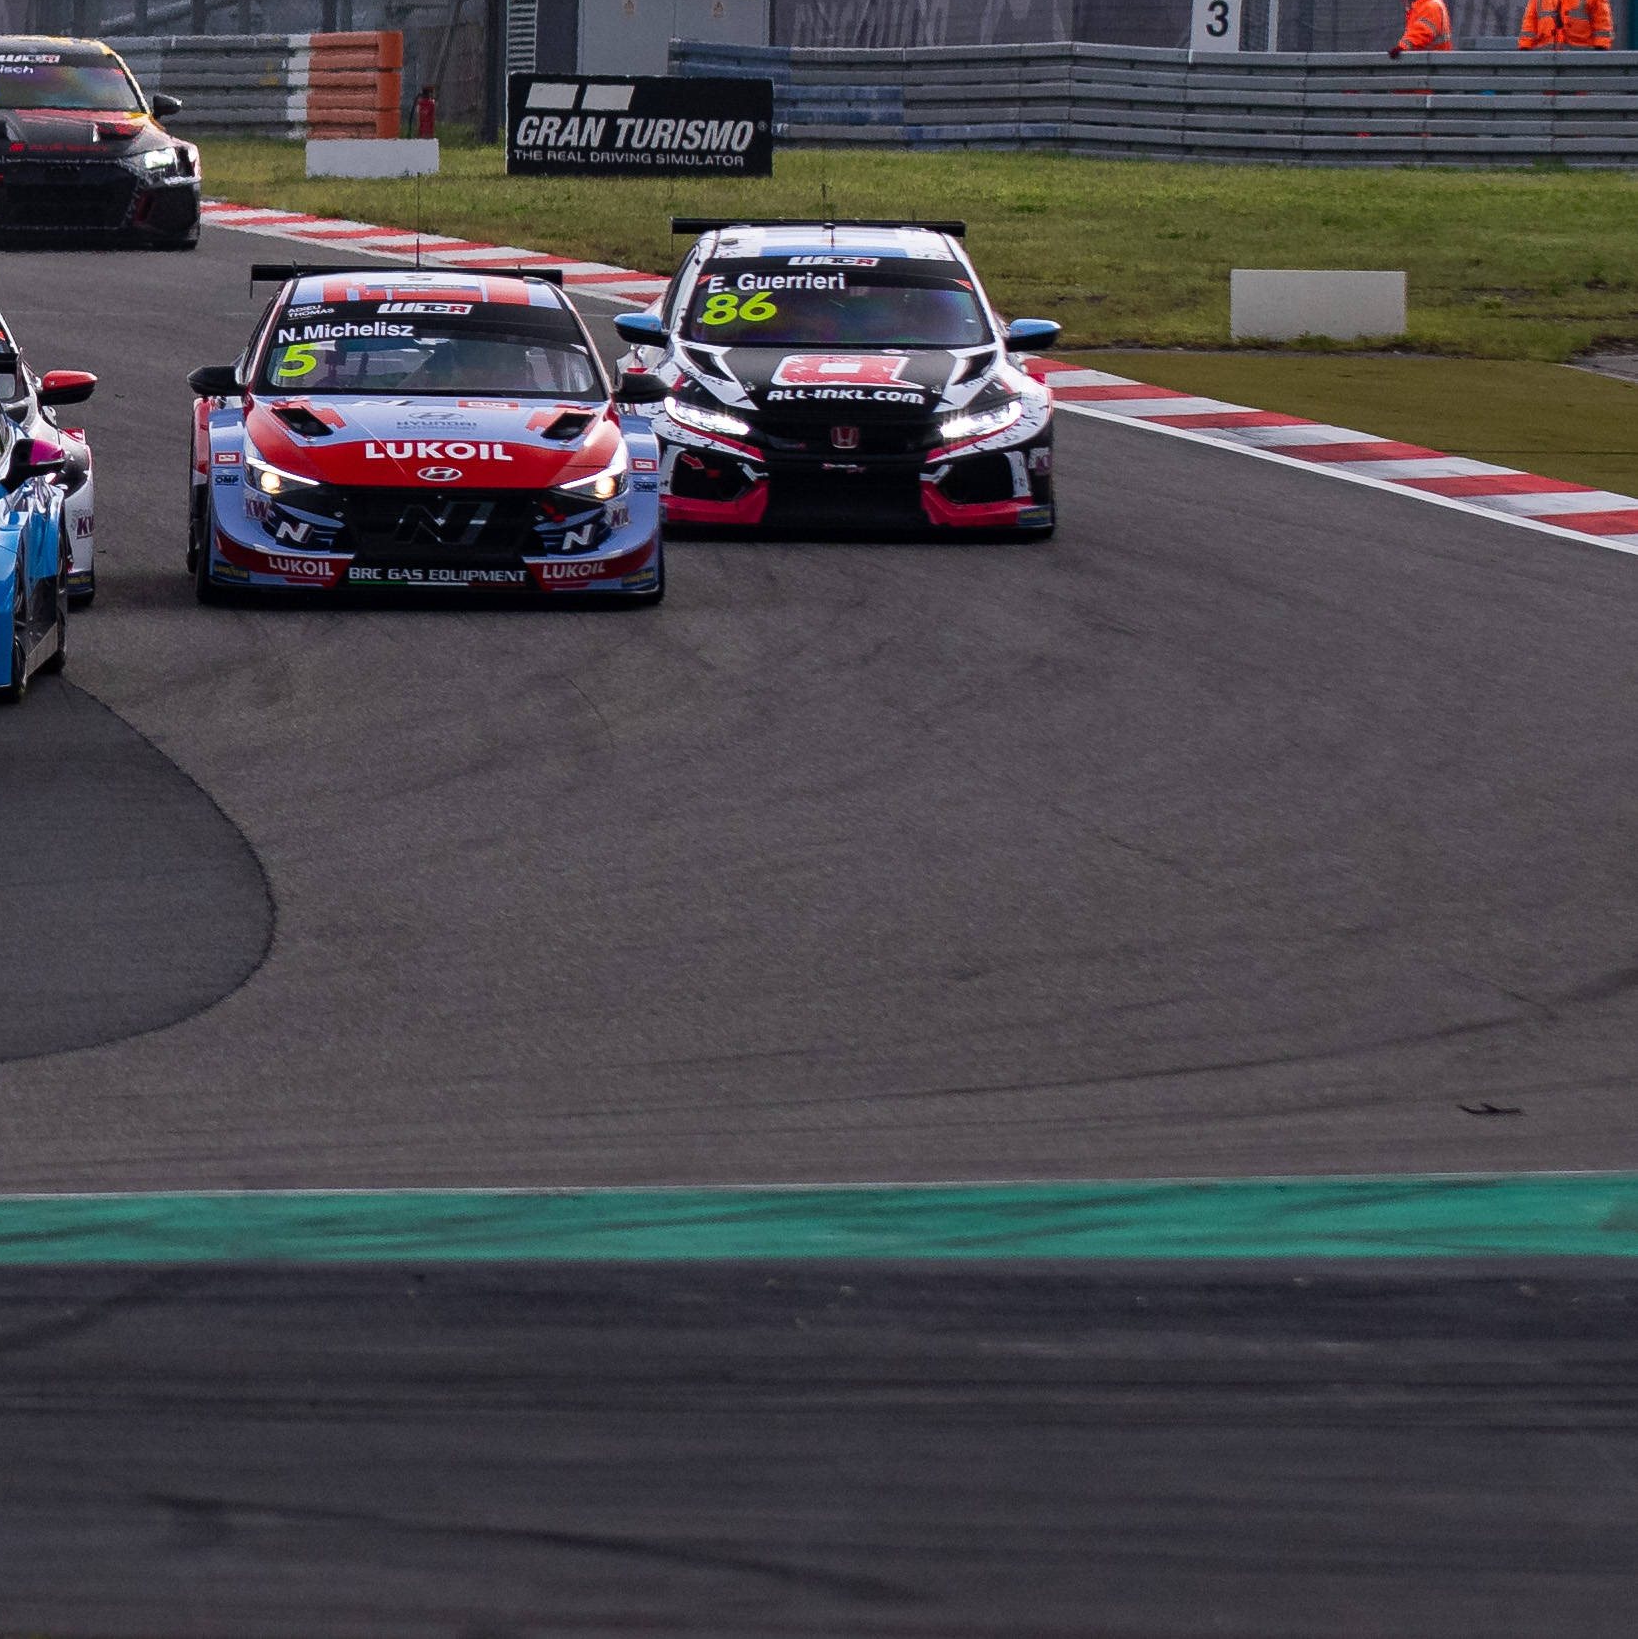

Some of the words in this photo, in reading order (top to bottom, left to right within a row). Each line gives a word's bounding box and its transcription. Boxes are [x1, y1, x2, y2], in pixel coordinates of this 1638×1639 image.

[1206, 0, 1229, 37] 3
[516, 116, 605, 147] GRAN
[614, 118, 754, 152] TURISMO
[514, 150, 543, 161] THE
[550, 150, 585, 163] REAL
[590, 151, 652, 164] DRIVING
[656, 153, 744, 167] SIMULATOR
[707, 276, 729, 294] E.
[737, 272, 845, 290] Guerrieri
[376, 303, 473, 314] WTCR
[701, 291, 777, 326] 86
[278, 342, 318, 377] 5
[365, 442, 513, 461] LUKOIL
[215, 474, 239, 486] OMP
[245, 498, 271, 518] KW
[268, 556, 334, 576] LUKOIL
[349, 567, 383, 580] BRC
[388, 568, 423, 581] GAS
[429, 569, 526, 582] EQUIPMENT
[542, 562, 605, 579] LUKOIL
